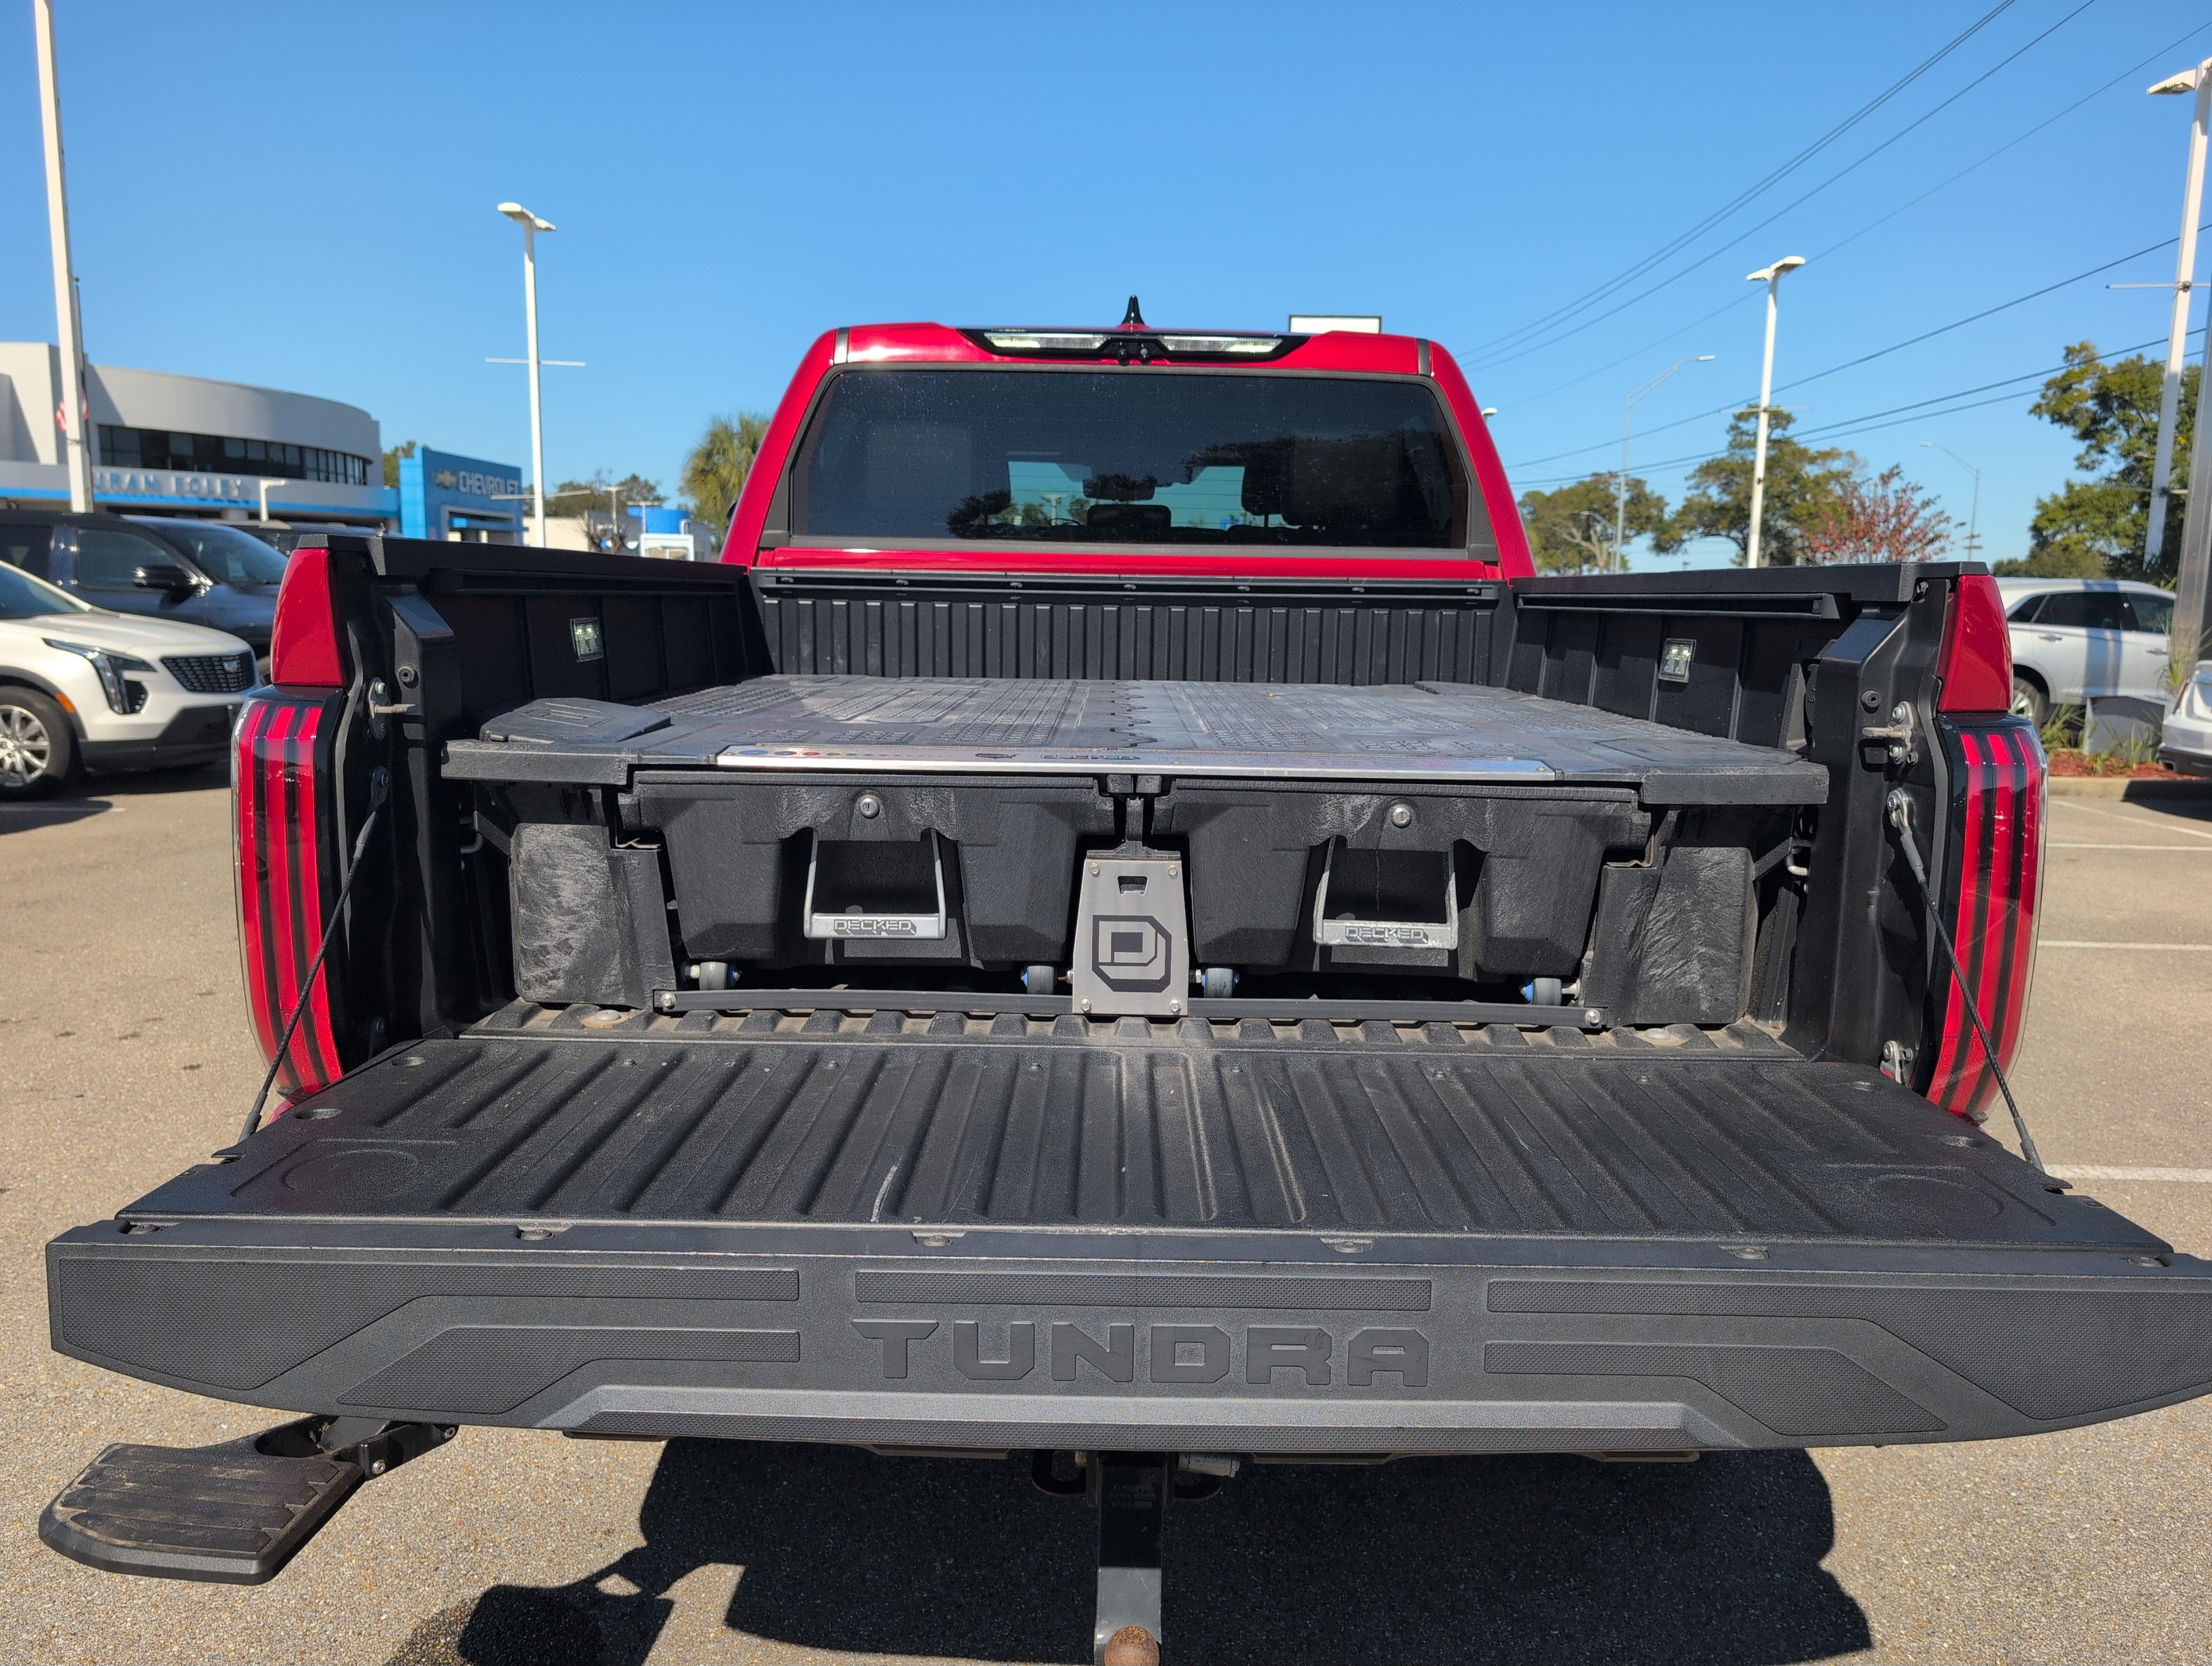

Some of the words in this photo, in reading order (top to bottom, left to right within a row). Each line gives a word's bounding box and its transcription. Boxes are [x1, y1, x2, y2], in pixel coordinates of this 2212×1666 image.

[172, 475, 243, 497] FOLEY
[458, 470, 519, 495] CHEVROLET
[834, 919, 916, 934] DECKED
[1345, 926, 1428, 943] DECKED
[851, 1318, 1430, 1386] TUNDRA
